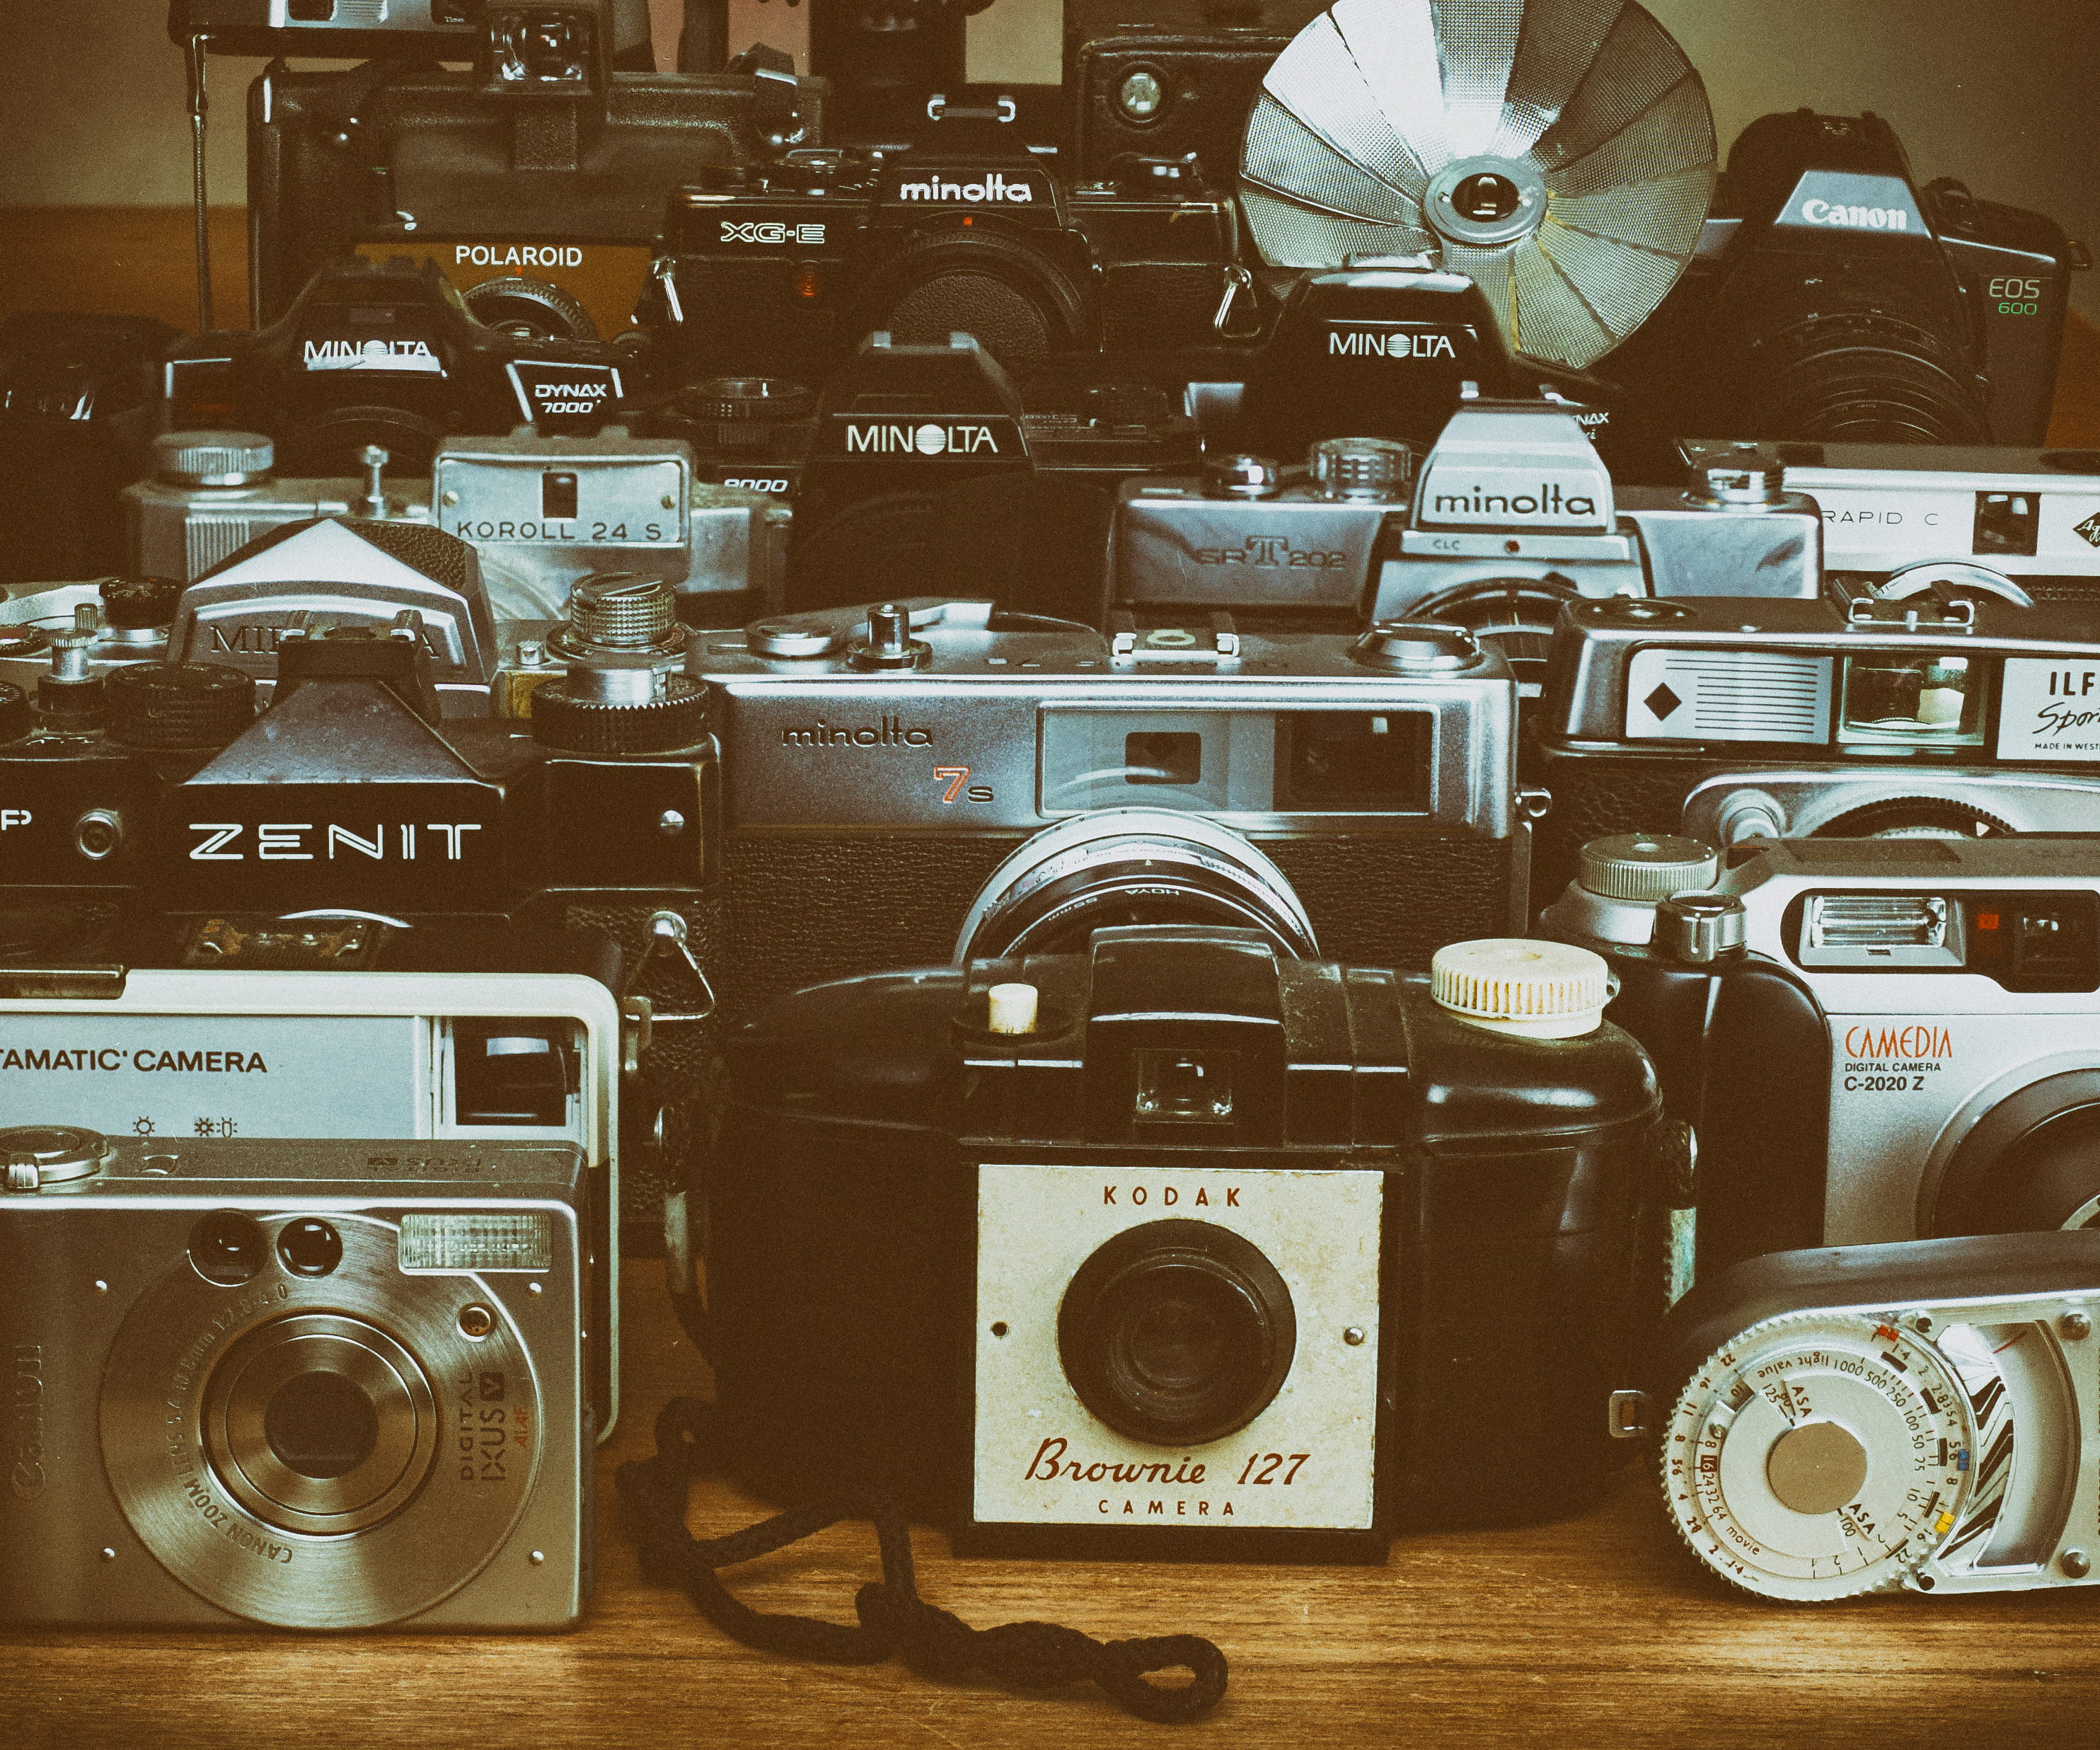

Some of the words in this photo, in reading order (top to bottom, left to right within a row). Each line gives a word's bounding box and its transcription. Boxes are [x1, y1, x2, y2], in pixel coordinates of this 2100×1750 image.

[900, 173, 1032, 202] minolta
[1802, 198, 1907, 230] Canon
[720, 222, 825, 243] XG-E
[456, 246, 582, 267] POLAROID
[1989, 278, 2041, 299] EOS
[1998, 302, 2038, 316] 600
[1329, 333, 1455, 358] MINOLTA
[535, 384, 607, 397] DYNAX
[1575, 412, 1609, 425] NAX
[848, 425, 998, 455] MINOLTA
[1436, 483, 1596, 515] minolta
[1823, 510, 1903, 525] RAPID
[1925, 513, 1939, 526] C
[458, 521, 576, 539] KOROLL
[592, 522, 628, 541] 24
[645, 523, 662, 541] S
[2049, 672, 2099, 696] ILF
[2032, 701, 2100, 737] Spor
[782, 715, 934, 747] minolta
[189, 824, 482, 860] ZENIT
[1845, 1025, 1953, 1058] CAMEDIA
[133, 1049, 267, 1073] CAMERA
[1845, 1062, 1889, 1072] DIGITAL
[1892, 1062, 1942, 1072] CAMERA
[1844, 1076, 1908, 1091] C-2020
[1912, 1076, 1925, 1091] Z
[1103, 1185, 1241, 1207] KODAK
[1757, 1359, 1793, 1378] value
[1798, 1351, 1830, 1366] light
[1833, 1359, 1864, 1376] 1000
[1864, 1371, 1888, 1389] 500
[1792, 1386, 1813, 1419] ASA
[1885, 1386, 1907, 1408] 250
[460, 1370, 474, 1481] DIGITAL
[1903, 1410, 1920, 1432] 100
[480, 1408, 506, 1481] IXUS
[1912, 1434, 1925, 1450] 50
[1025, 1437, 1206, 1484] Brownie
[1237, 1453, 1310, 1485] 127
[1702, 1456, 1716, 1470] 16
[1914, 1456, 1926, 1472] 25
[1702, 1473, 1715, 1487] 24
[183, 1478, 229, 1529] ZOOM
[1705, 1488, 1720, 1504] 32
[1098, 1499, 1235, 1516] CAMERA
[1712, 1506, 1728, 1521] 64
[1840, 1516, 1857, 1537] 100
[1848, 1503, 1876, 1535] ASA
[1726, 1526, 1760, 1555] movie
